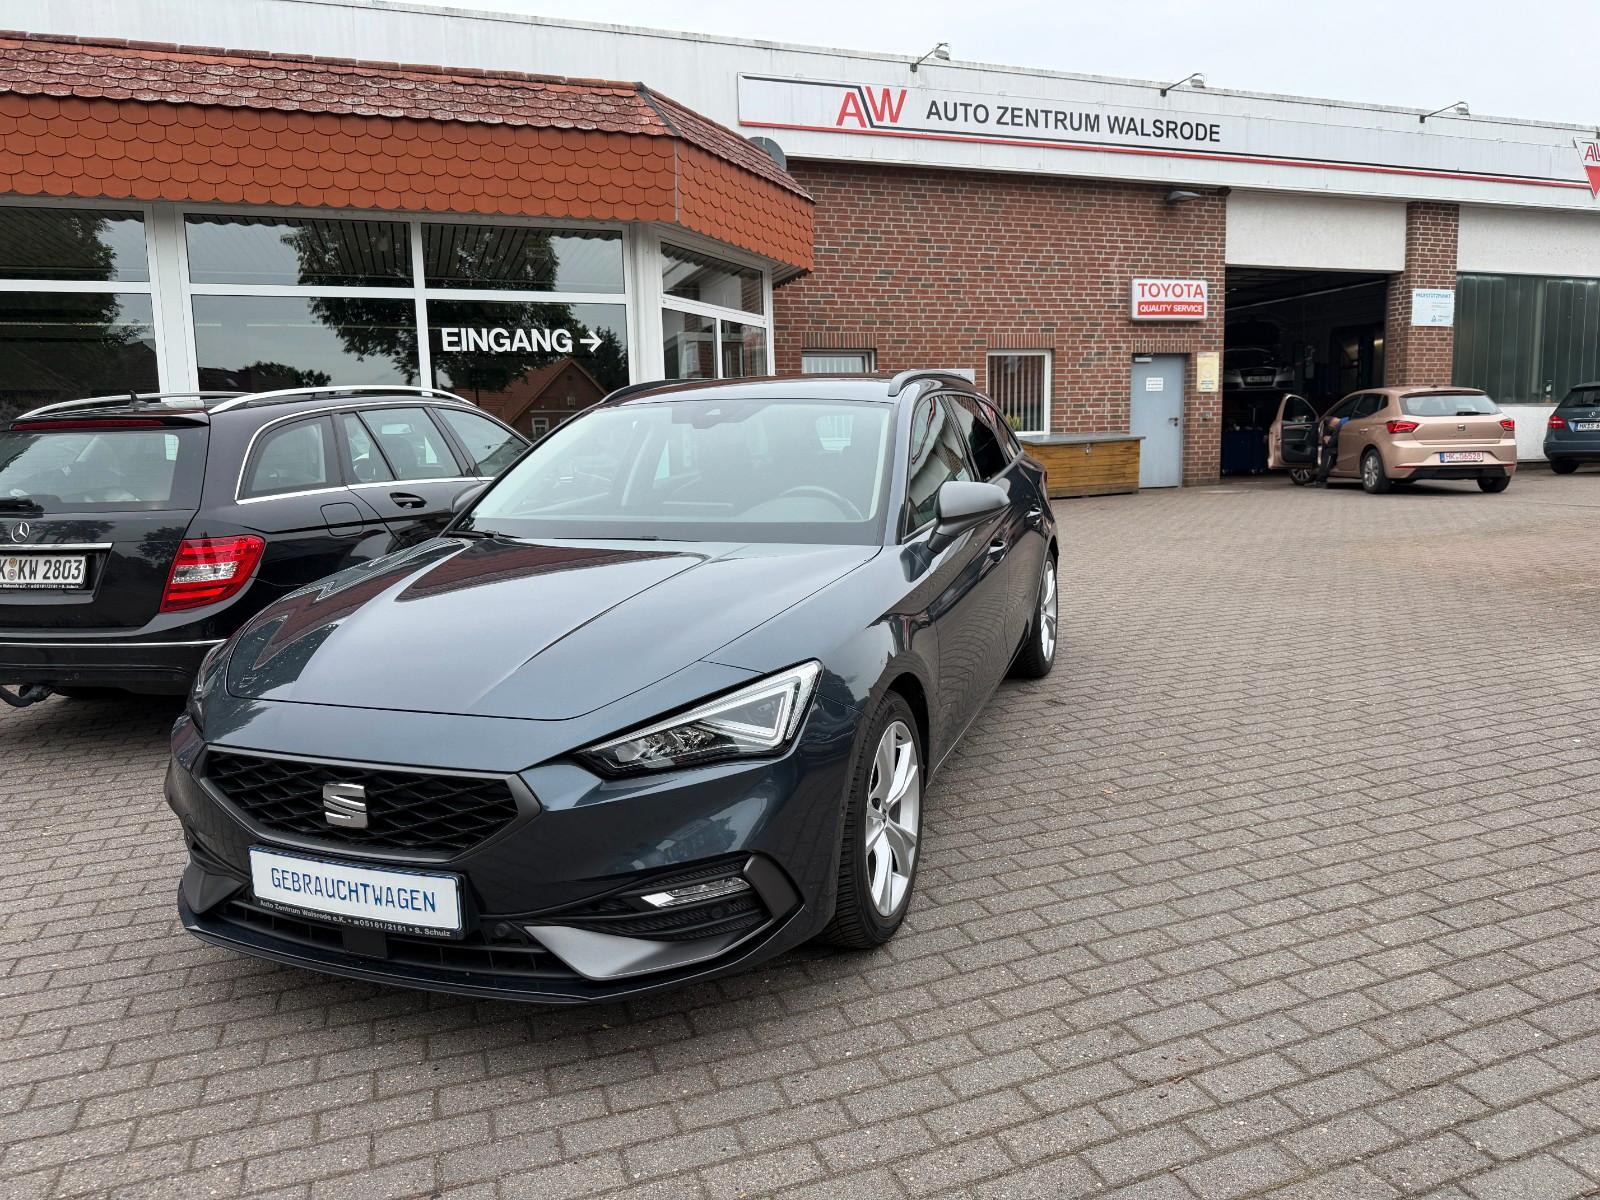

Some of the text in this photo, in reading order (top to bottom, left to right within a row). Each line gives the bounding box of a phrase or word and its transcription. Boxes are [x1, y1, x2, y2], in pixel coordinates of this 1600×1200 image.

[836, 85, 907, 129] AW
[926, 100, 1221, 144] AUTO ZENTRUM WALSRODE
[1138, 283, 1205, 298] TOYOTA
[1140, 304, 1203, 313] QUALITY SERVICE
[441, 327, 573, 353] EINGANG
[17, 560, 39, 580] KW
[43, 560, 83, 580] 2803
[271, 867, 436, 913] GEBRAUCHTWAGEN
[260, 899, 274, 909] Auto
[274, 903, 301, 915] Zentrum
[302, 908, 331, 921] Walsrode
[424, 927, 451, 937] Schulz
